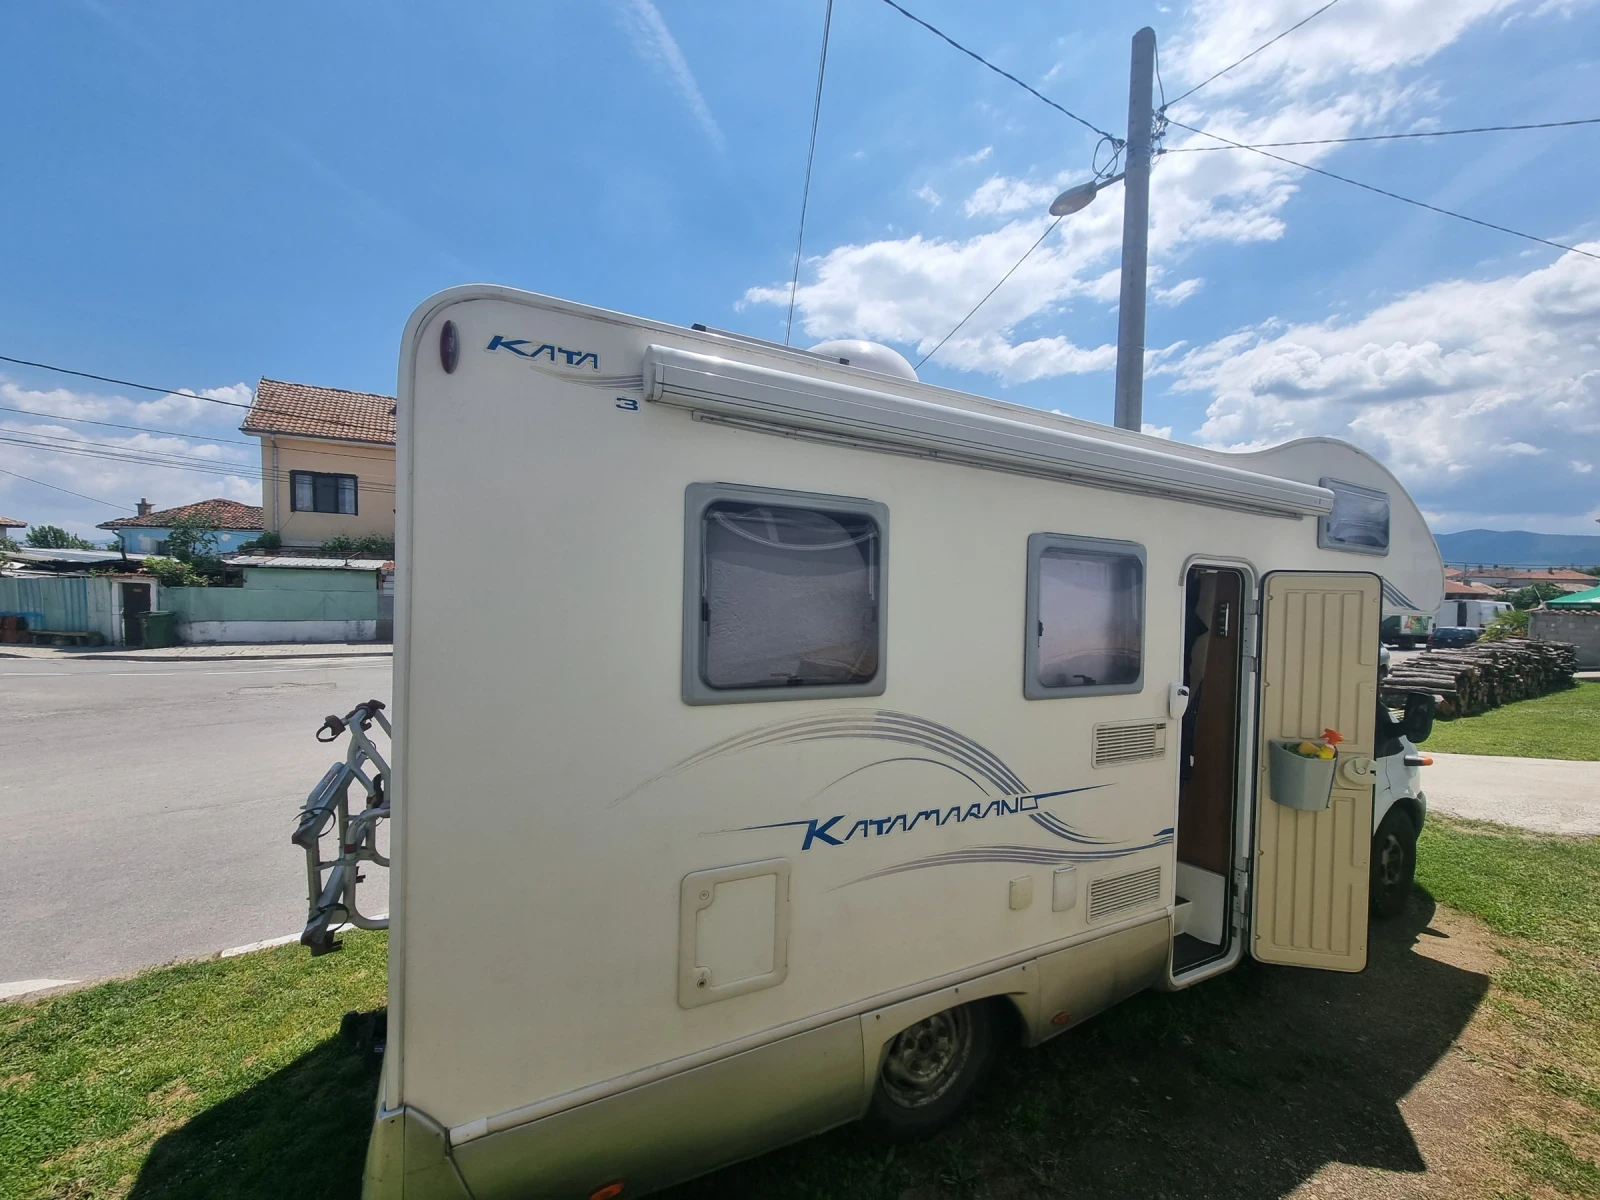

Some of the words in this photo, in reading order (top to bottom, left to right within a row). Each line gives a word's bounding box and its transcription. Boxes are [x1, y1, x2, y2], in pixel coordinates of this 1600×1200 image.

[486, 335, 598, 370] KATA
[615, 397, 639, 411] 3
[801, 796, 1039, 851] KATAMARANO
